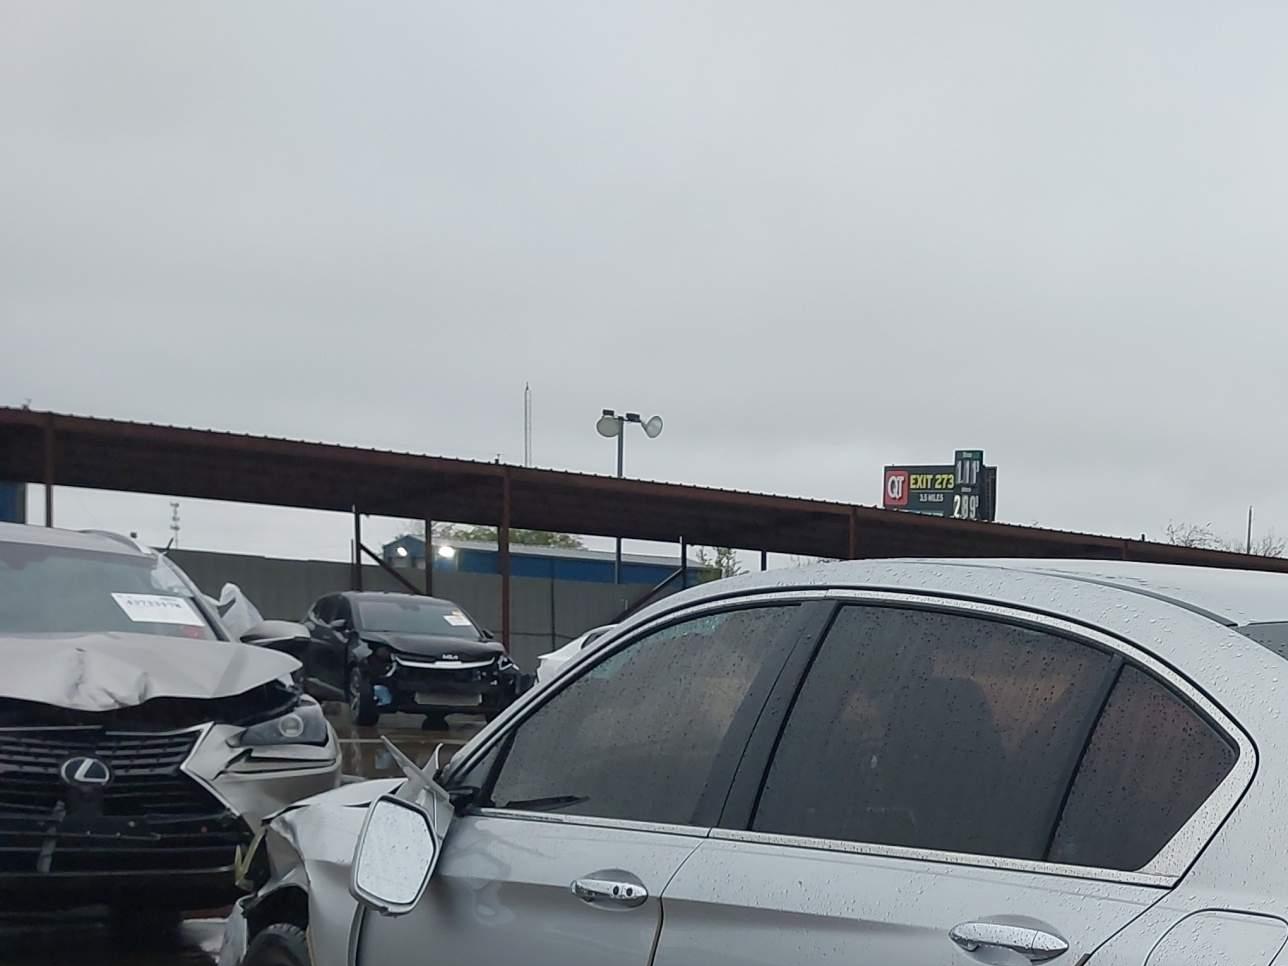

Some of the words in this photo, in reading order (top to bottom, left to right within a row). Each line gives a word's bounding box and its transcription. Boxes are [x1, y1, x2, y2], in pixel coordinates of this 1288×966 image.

[887, 475, 905, 500] QT
[910, 474, 934, 489] EXIT
[935, 474, 955, 489] 273
